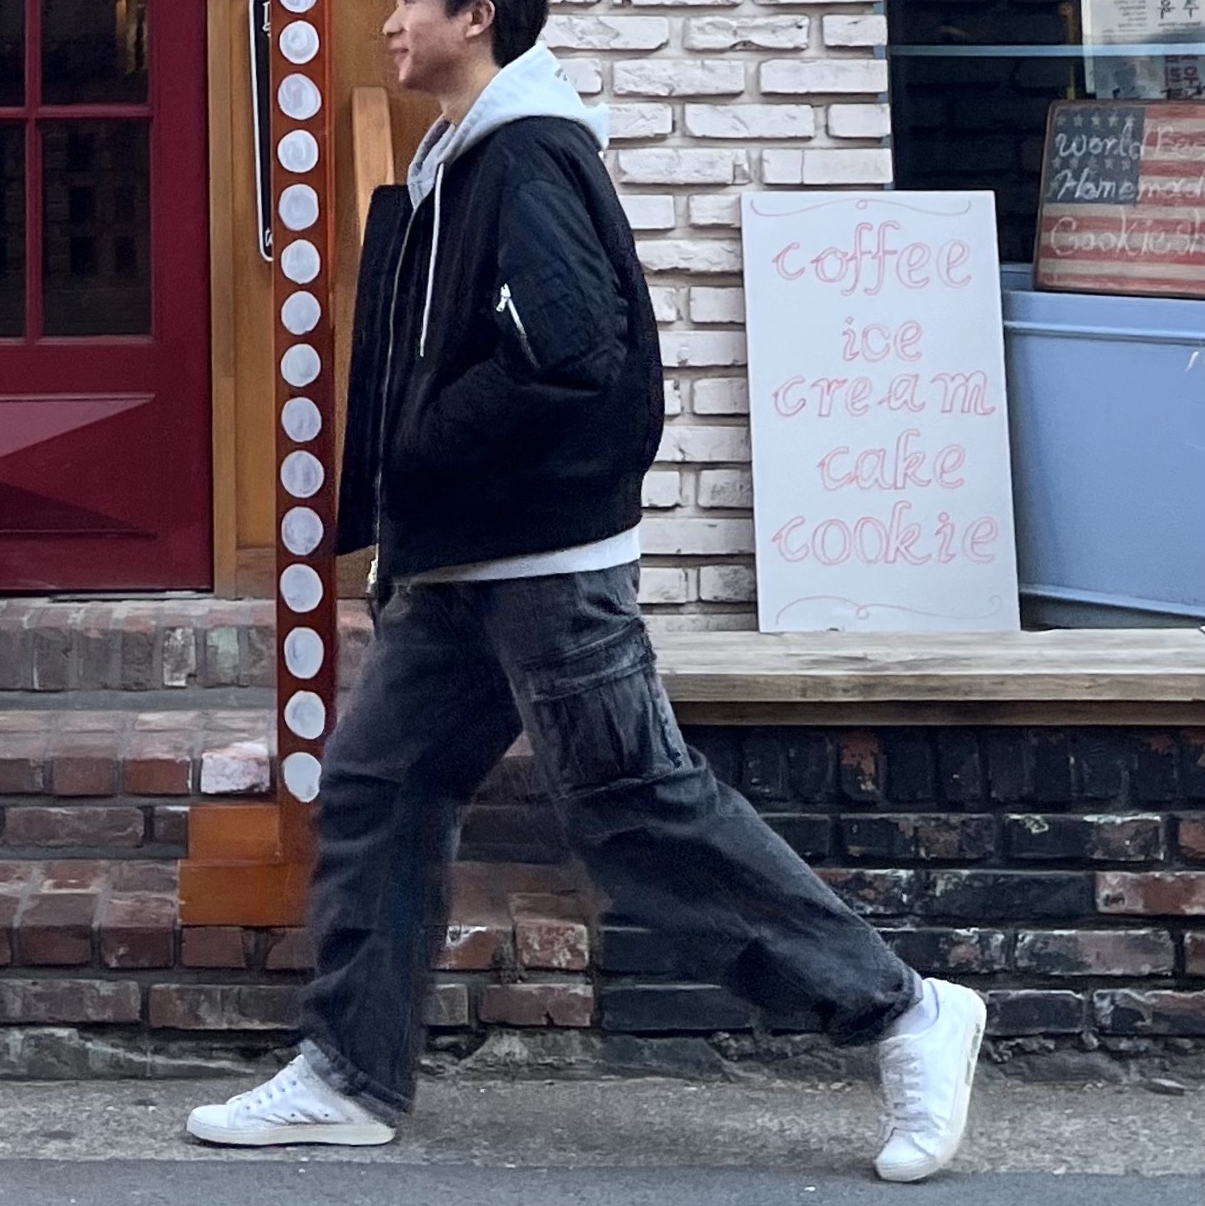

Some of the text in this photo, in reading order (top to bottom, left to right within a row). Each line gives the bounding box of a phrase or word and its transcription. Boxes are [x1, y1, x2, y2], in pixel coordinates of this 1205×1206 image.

[772, 220, 973, 296] coffee
[842, 316, 923, 363] ice
[772, 370, 997, 418] cream
[817, 428, 966, 491] cake
[771, 500, 1000, 566] cookie
